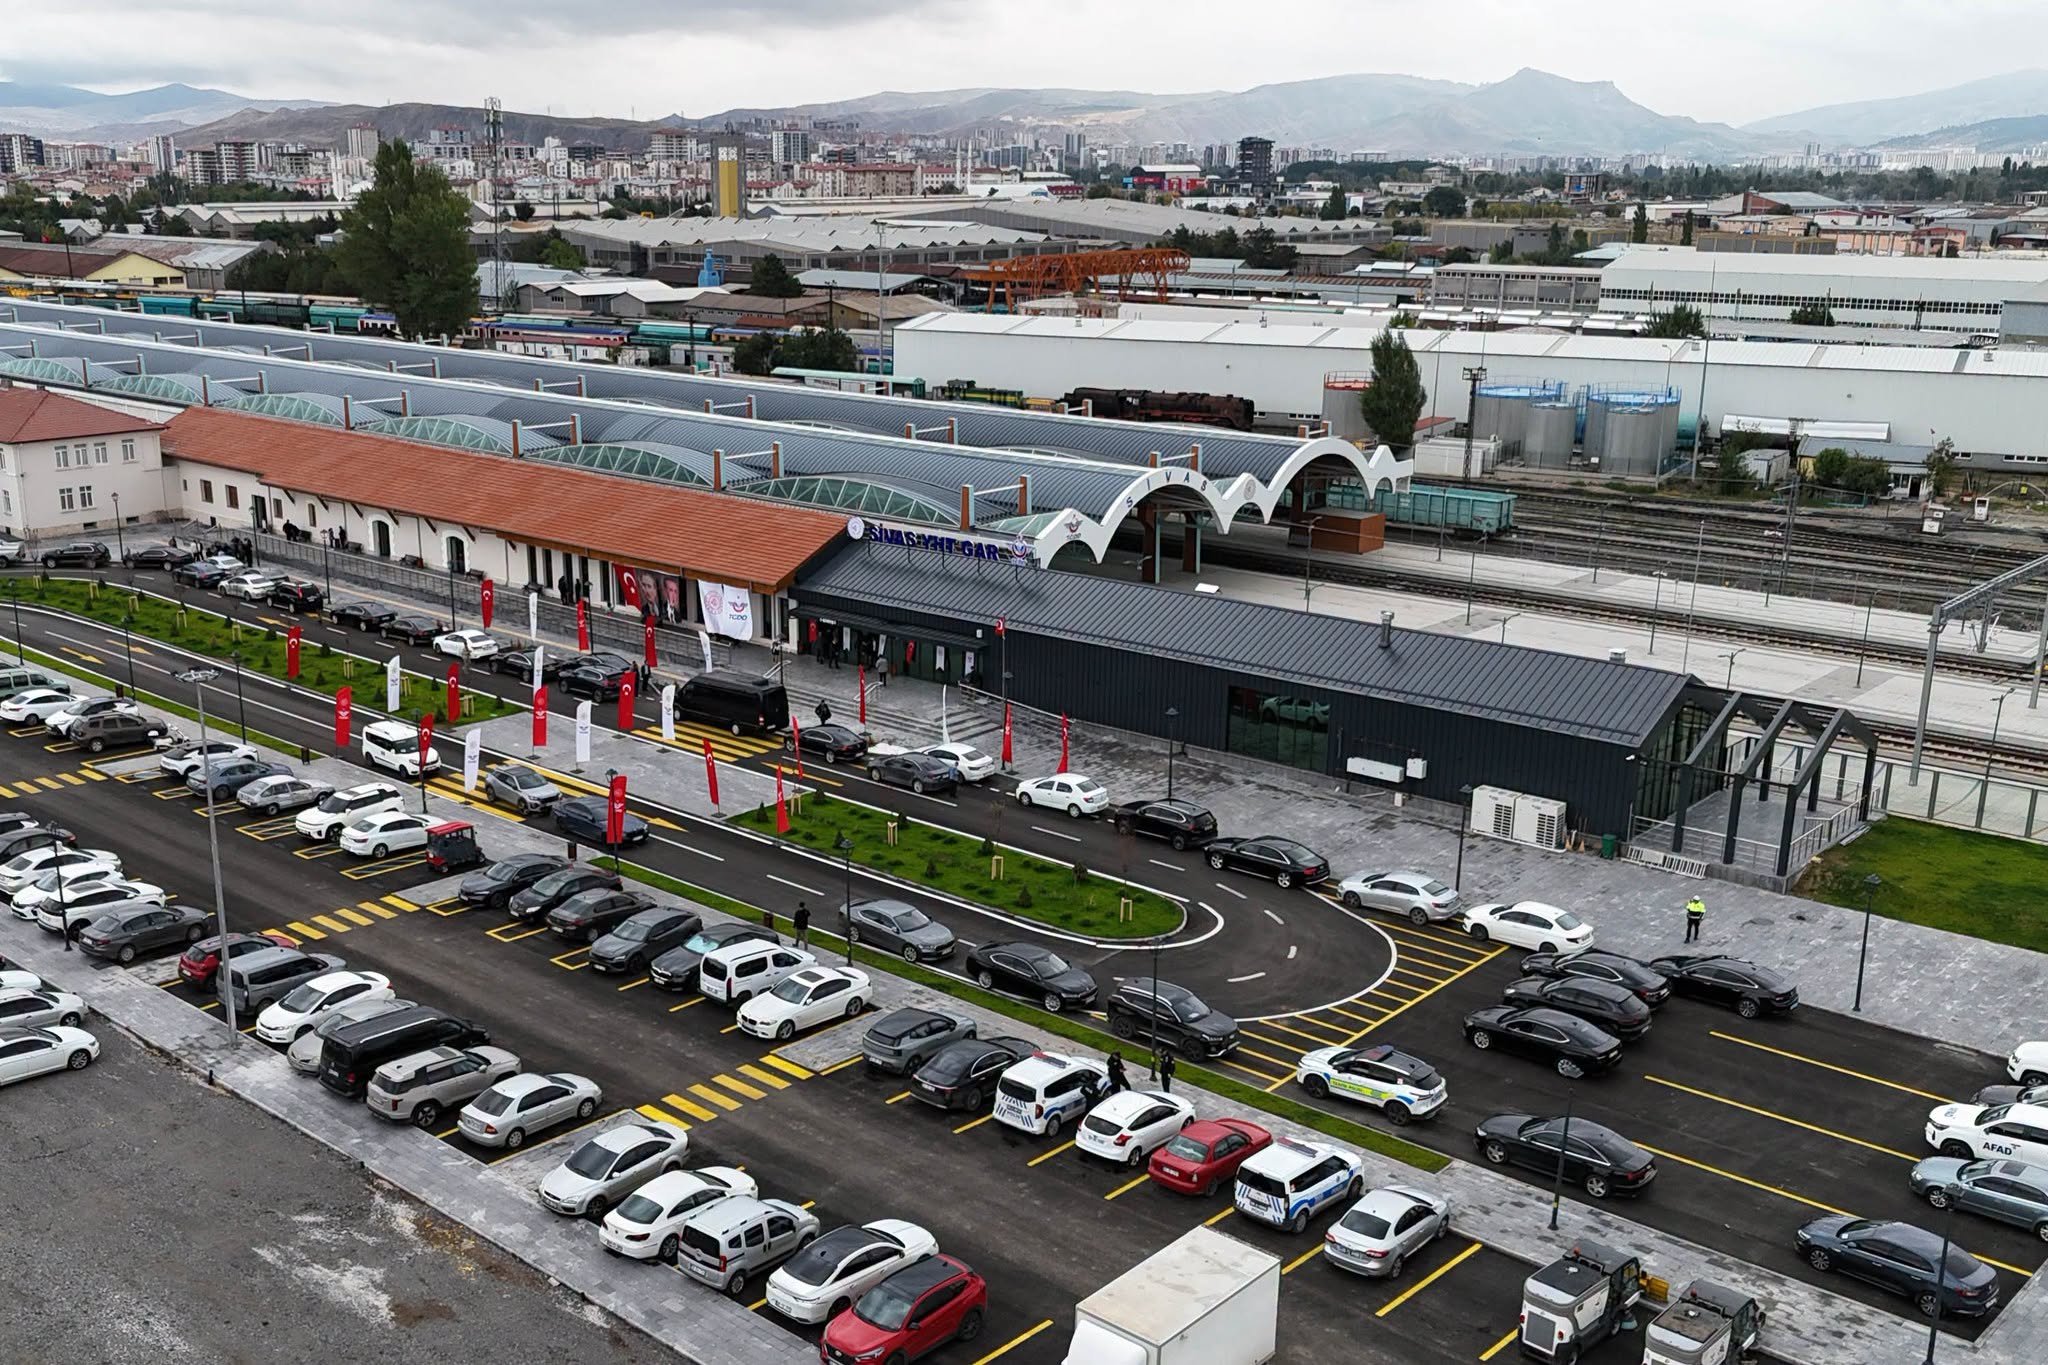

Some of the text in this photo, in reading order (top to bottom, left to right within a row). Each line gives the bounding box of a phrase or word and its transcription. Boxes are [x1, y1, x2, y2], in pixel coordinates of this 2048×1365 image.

[922, 533, 955, 553] YHT
[961, 540, 999, 561] GAR
[1982, 1142, 2012, 1156] AFAD
